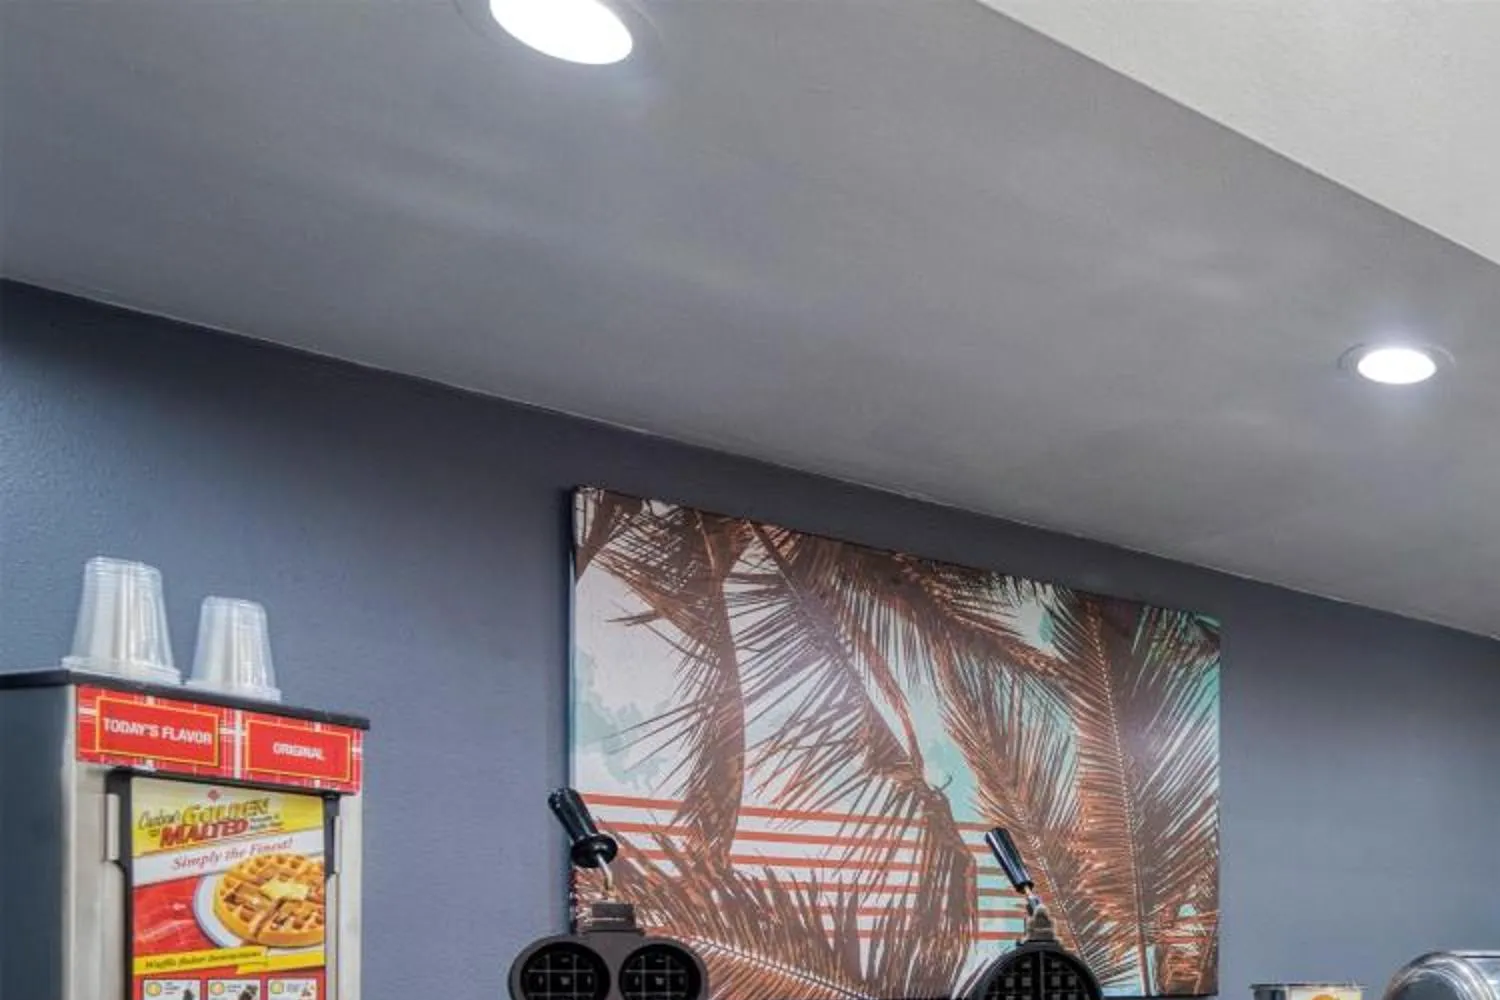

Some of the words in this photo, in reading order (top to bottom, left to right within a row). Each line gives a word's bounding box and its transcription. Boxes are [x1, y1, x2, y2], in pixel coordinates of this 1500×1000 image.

[103, 717, 159, 737] TODAY'S
[162, 726, 213, 746] FLAVOR
[272, 741, 325, 761] ORIGINAL
[160, 818, 249, 848] MALTED
[172, 850, 221, 870] Simply
[224, 846, 244, 860] the
[250, 837, 294, 857] Finest!
